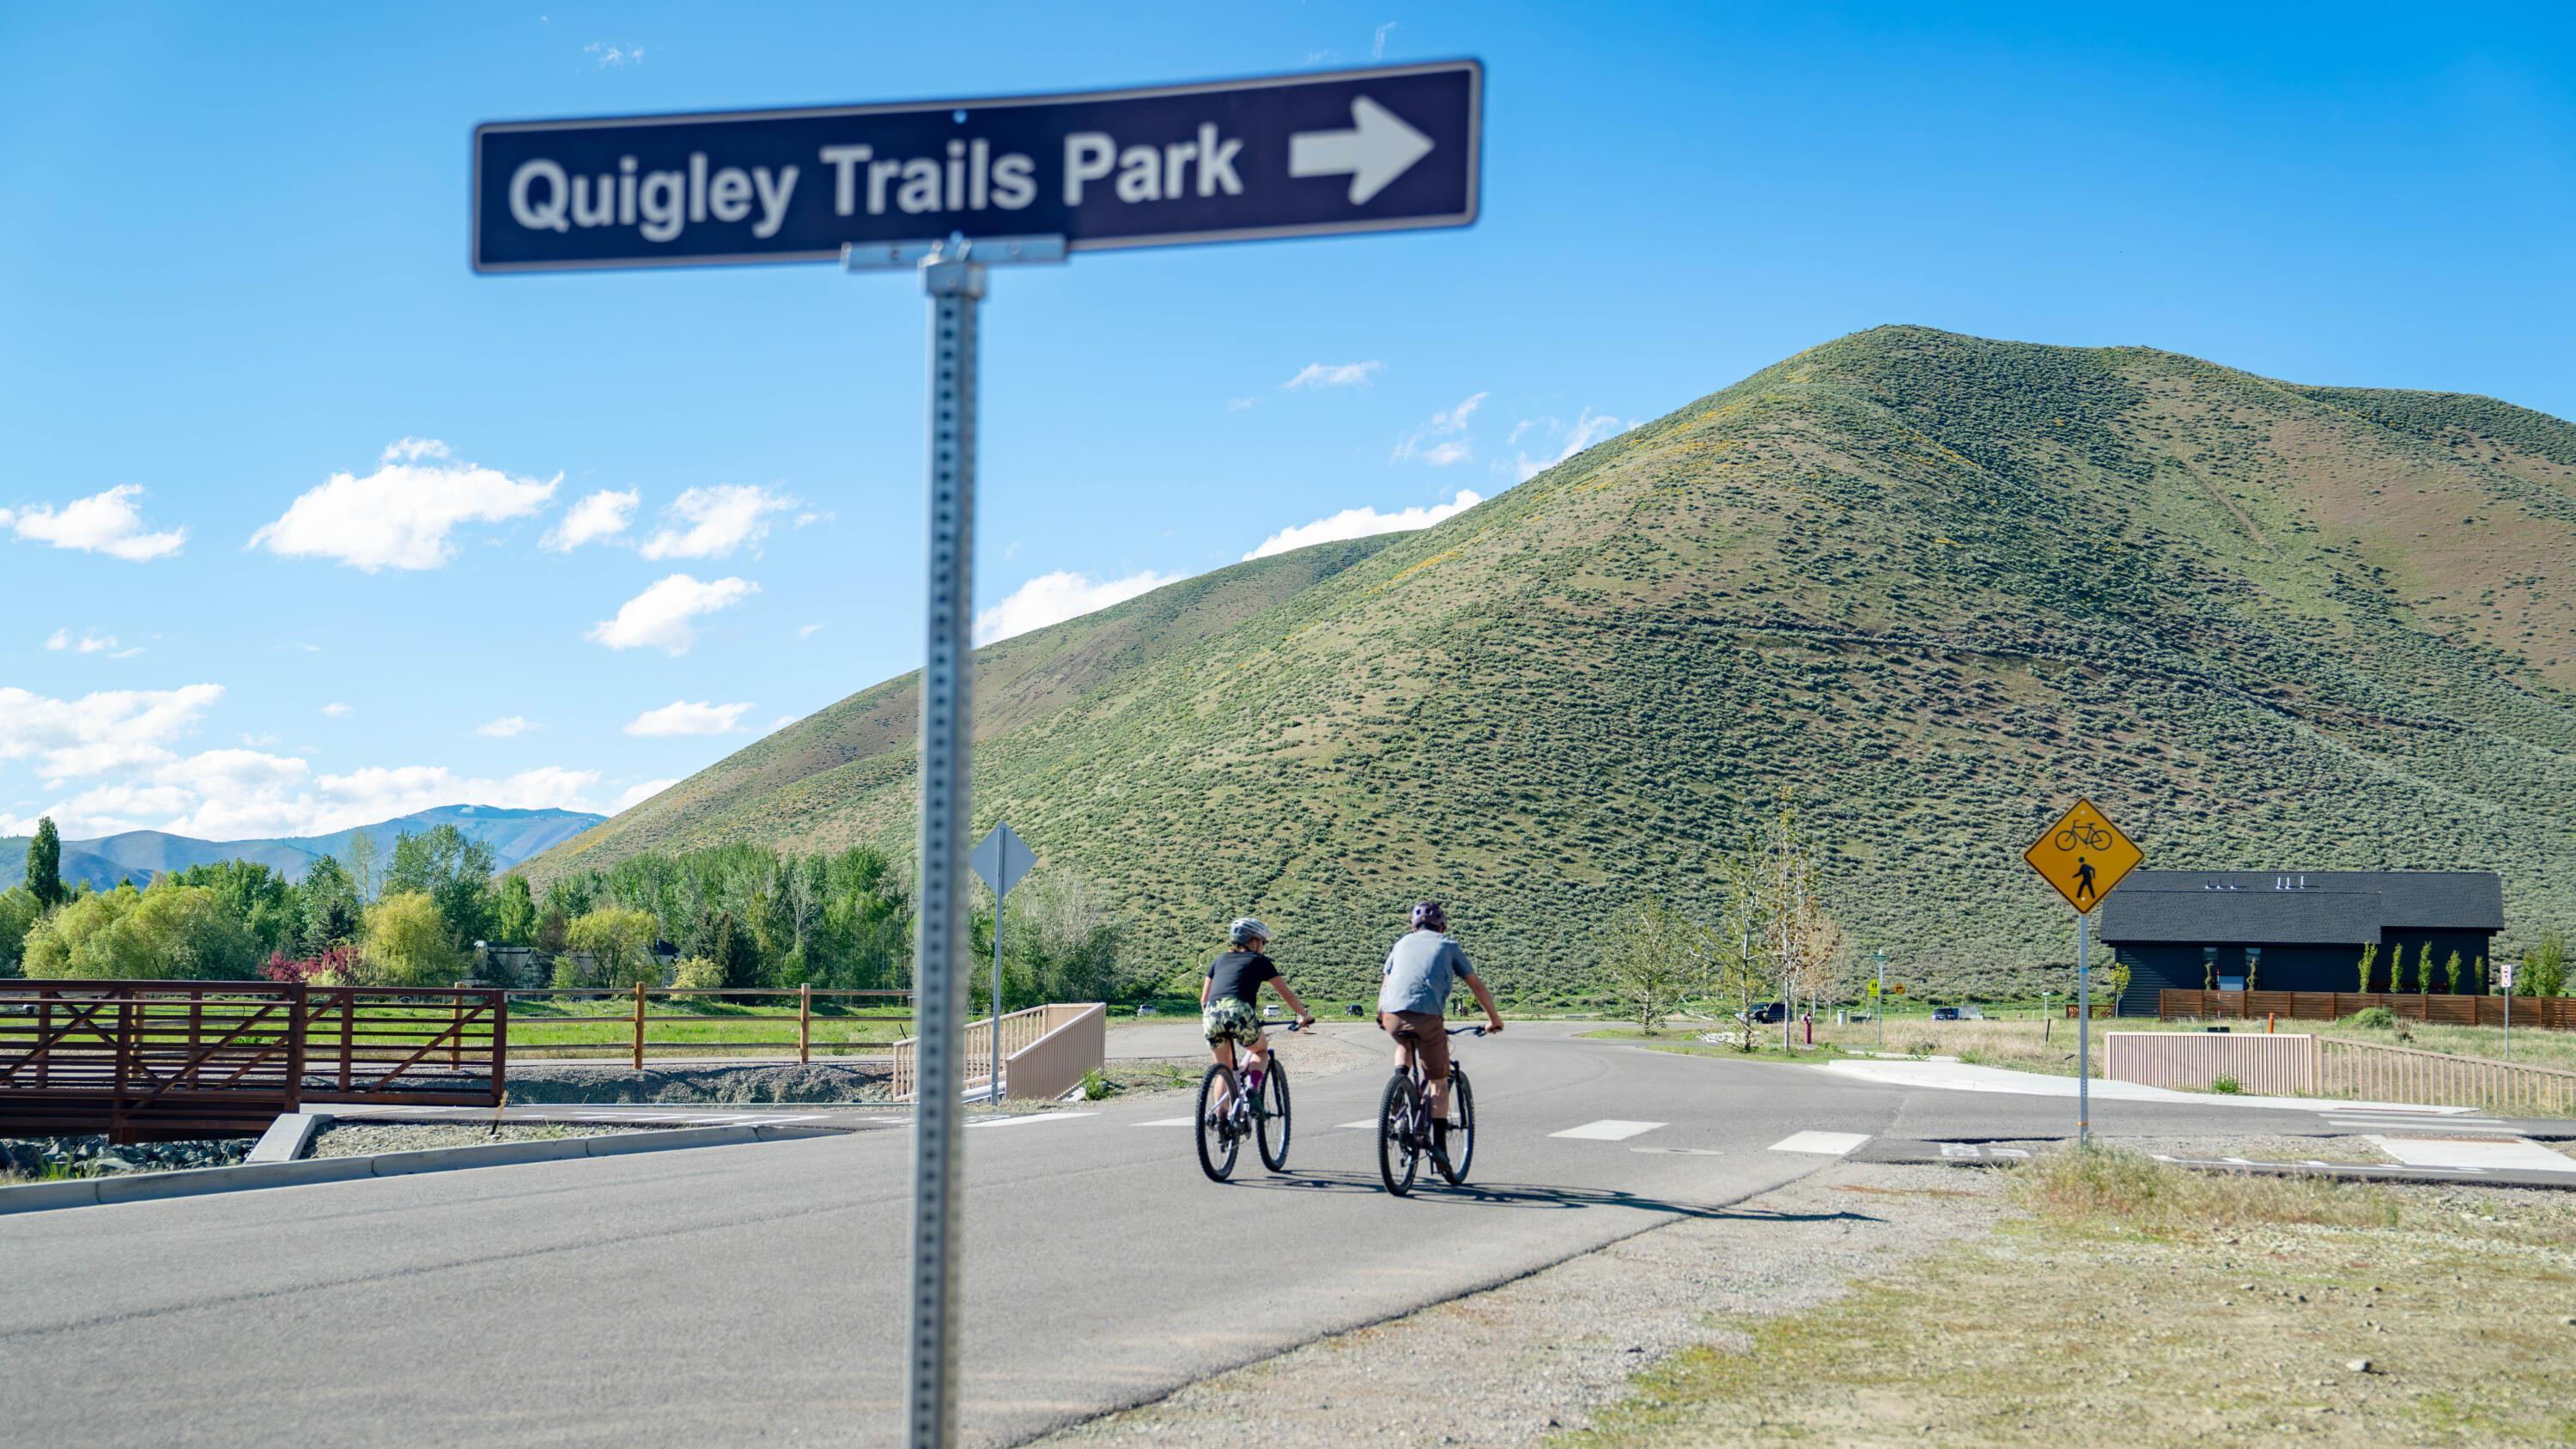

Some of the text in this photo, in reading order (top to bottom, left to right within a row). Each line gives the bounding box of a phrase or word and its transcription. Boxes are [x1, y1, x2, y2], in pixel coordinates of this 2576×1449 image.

[510, 123, 1242, 241] Quigley Trails Park
